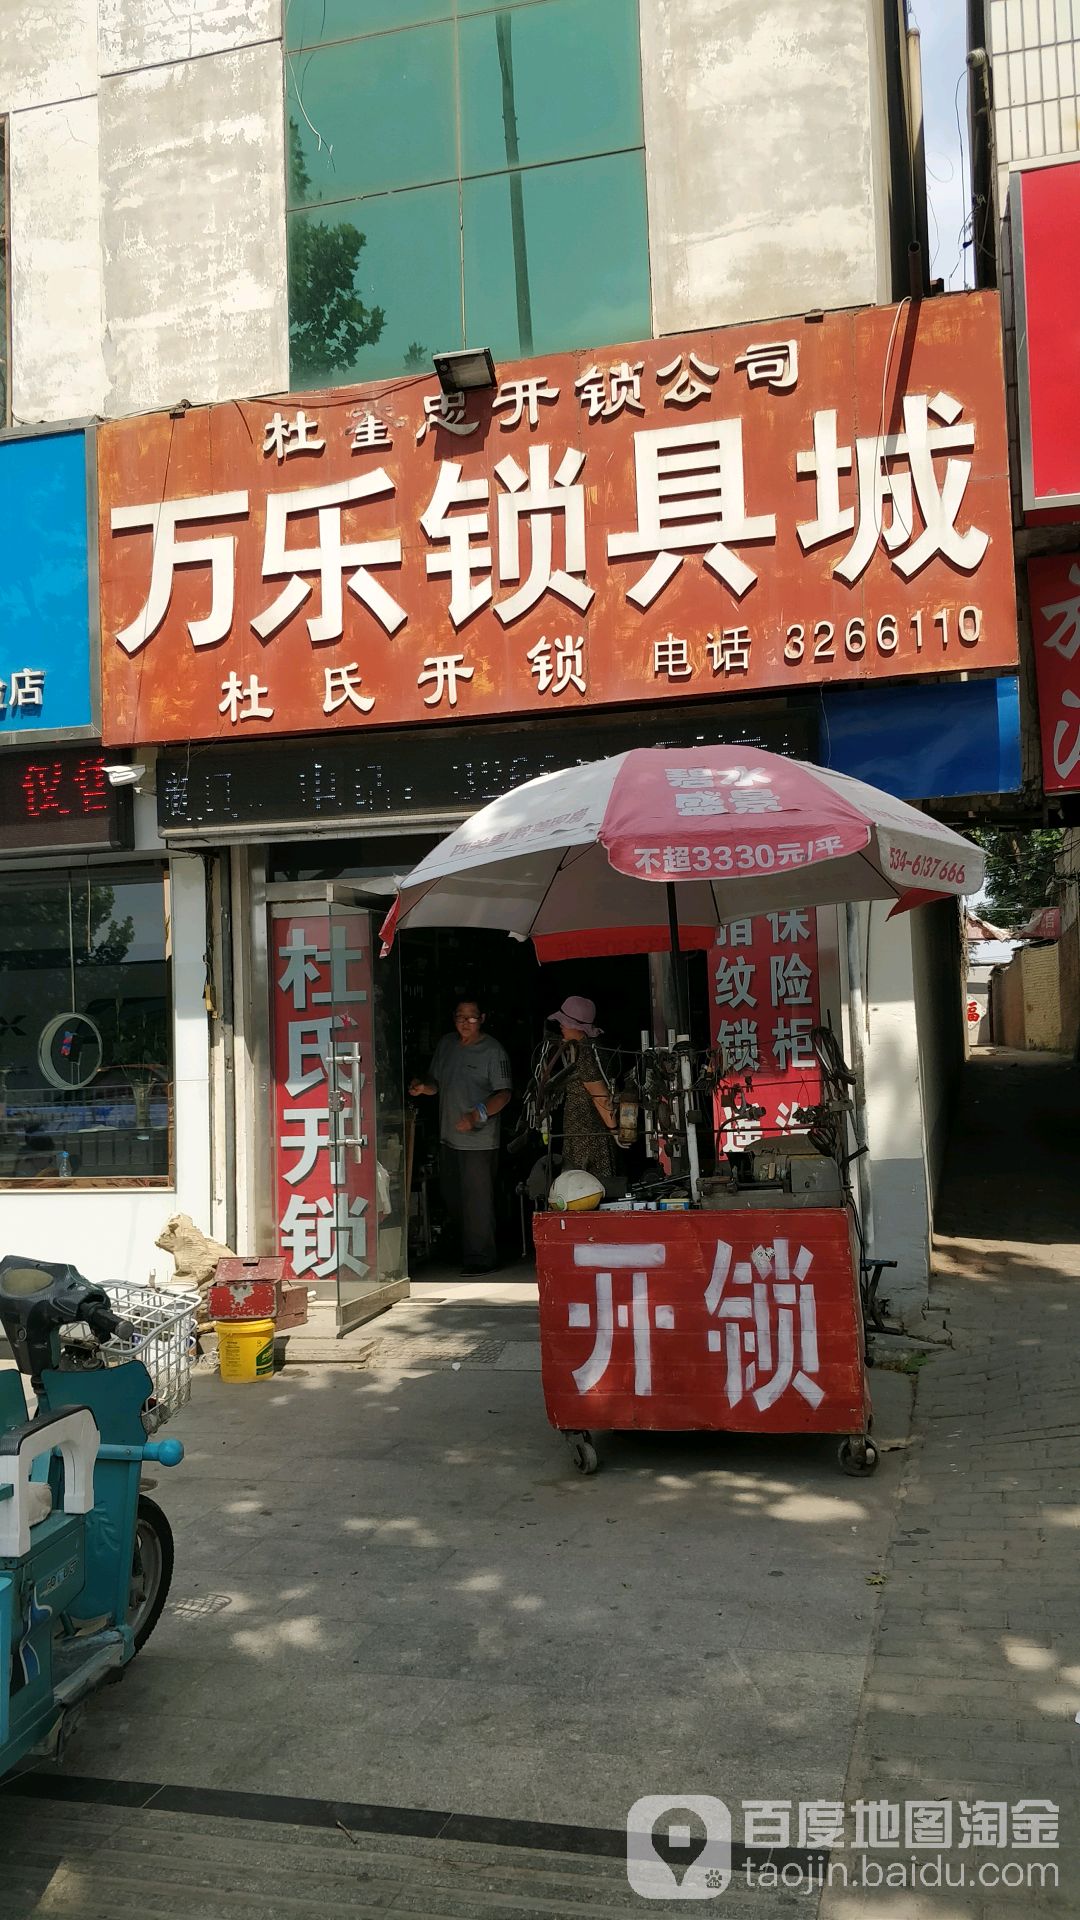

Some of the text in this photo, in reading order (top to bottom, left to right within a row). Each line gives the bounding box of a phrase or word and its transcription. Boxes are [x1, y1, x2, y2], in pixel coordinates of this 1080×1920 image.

[110, 391, 990, 654] 万乐锁具城
[219, 605, 983, 723] 杜氏开锁 电话 3266110
[0, 667, 45, 708] 店
[665, 766, 772, 788] 碧水
[675, 789, 783, 816] 盛景
[634, 835, 844, 875] 不超3330元/平
[889, 847, 966, 884] 534-6137666
[278, 926, 368, 1278] 杜氏开锁
[568, 1238, 826, 1412] 开锁
